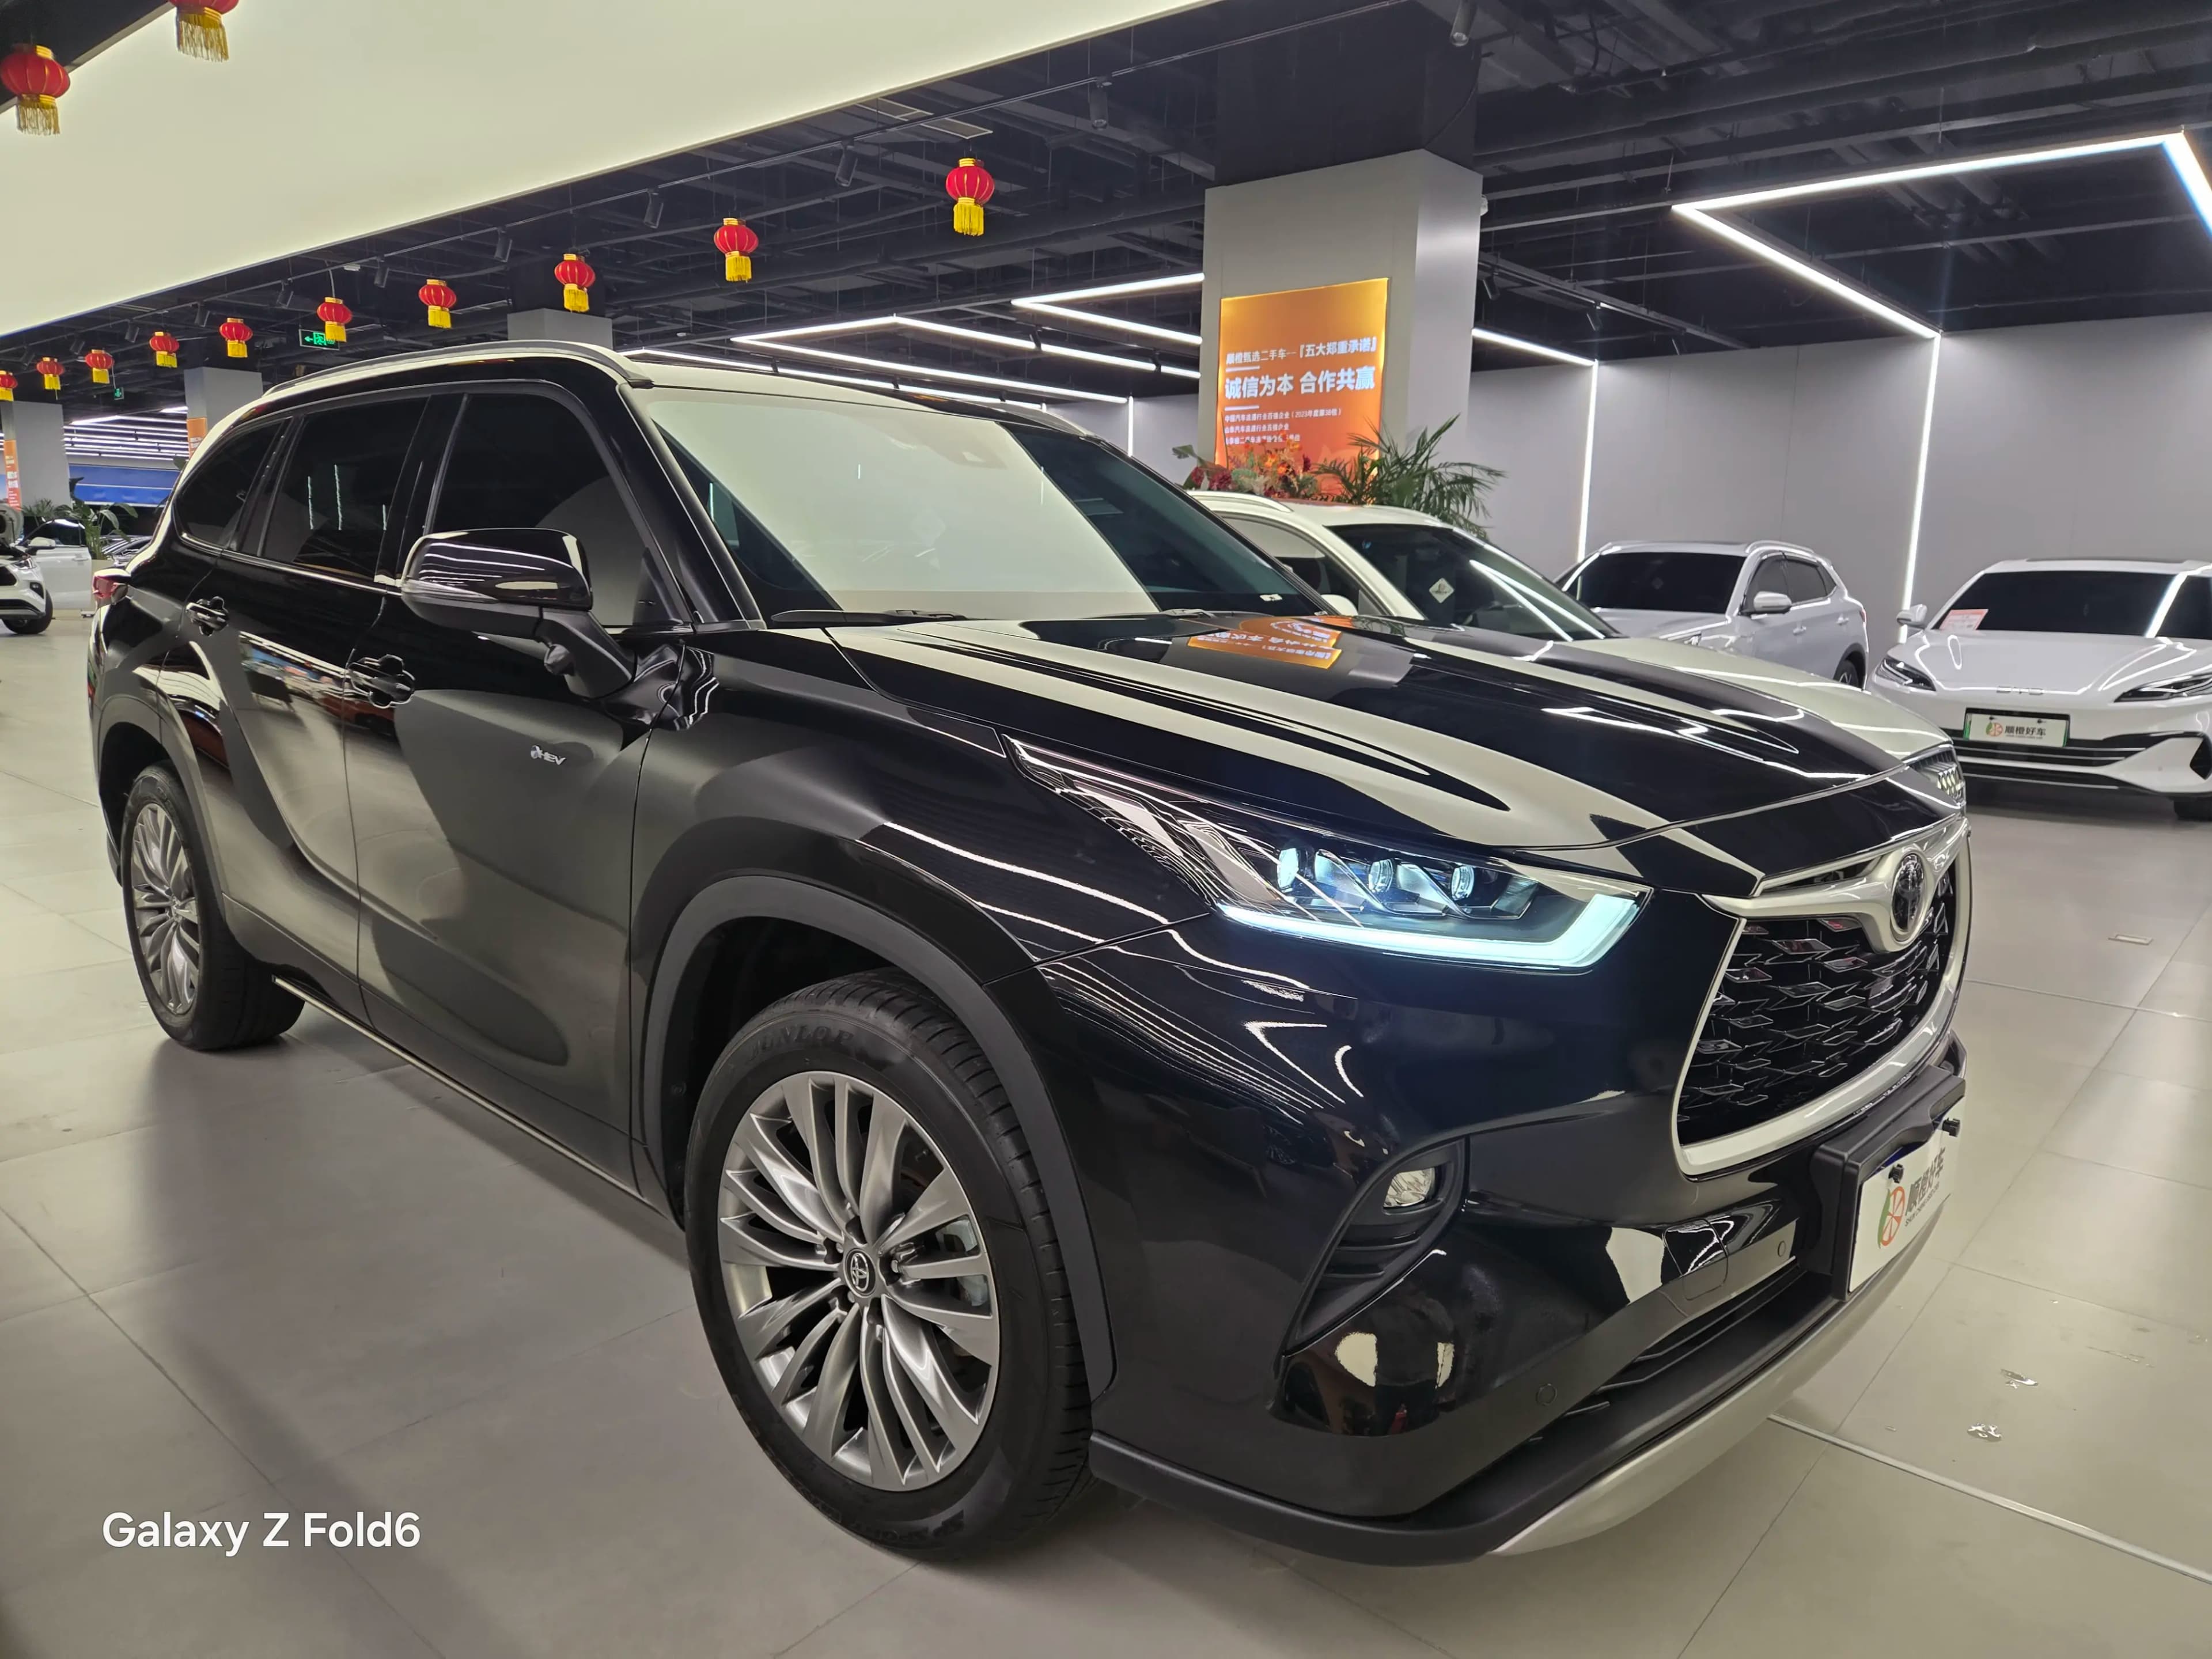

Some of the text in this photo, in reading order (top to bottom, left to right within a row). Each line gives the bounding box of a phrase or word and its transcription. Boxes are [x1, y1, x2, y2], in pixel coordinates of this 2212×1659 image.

[1225, 365, 1376, 400] 诚信为本 合作共赢
[2005, 725, 2046, 736] 顺橙好车
[748, 1024, 854, 1062] DUNLOP
